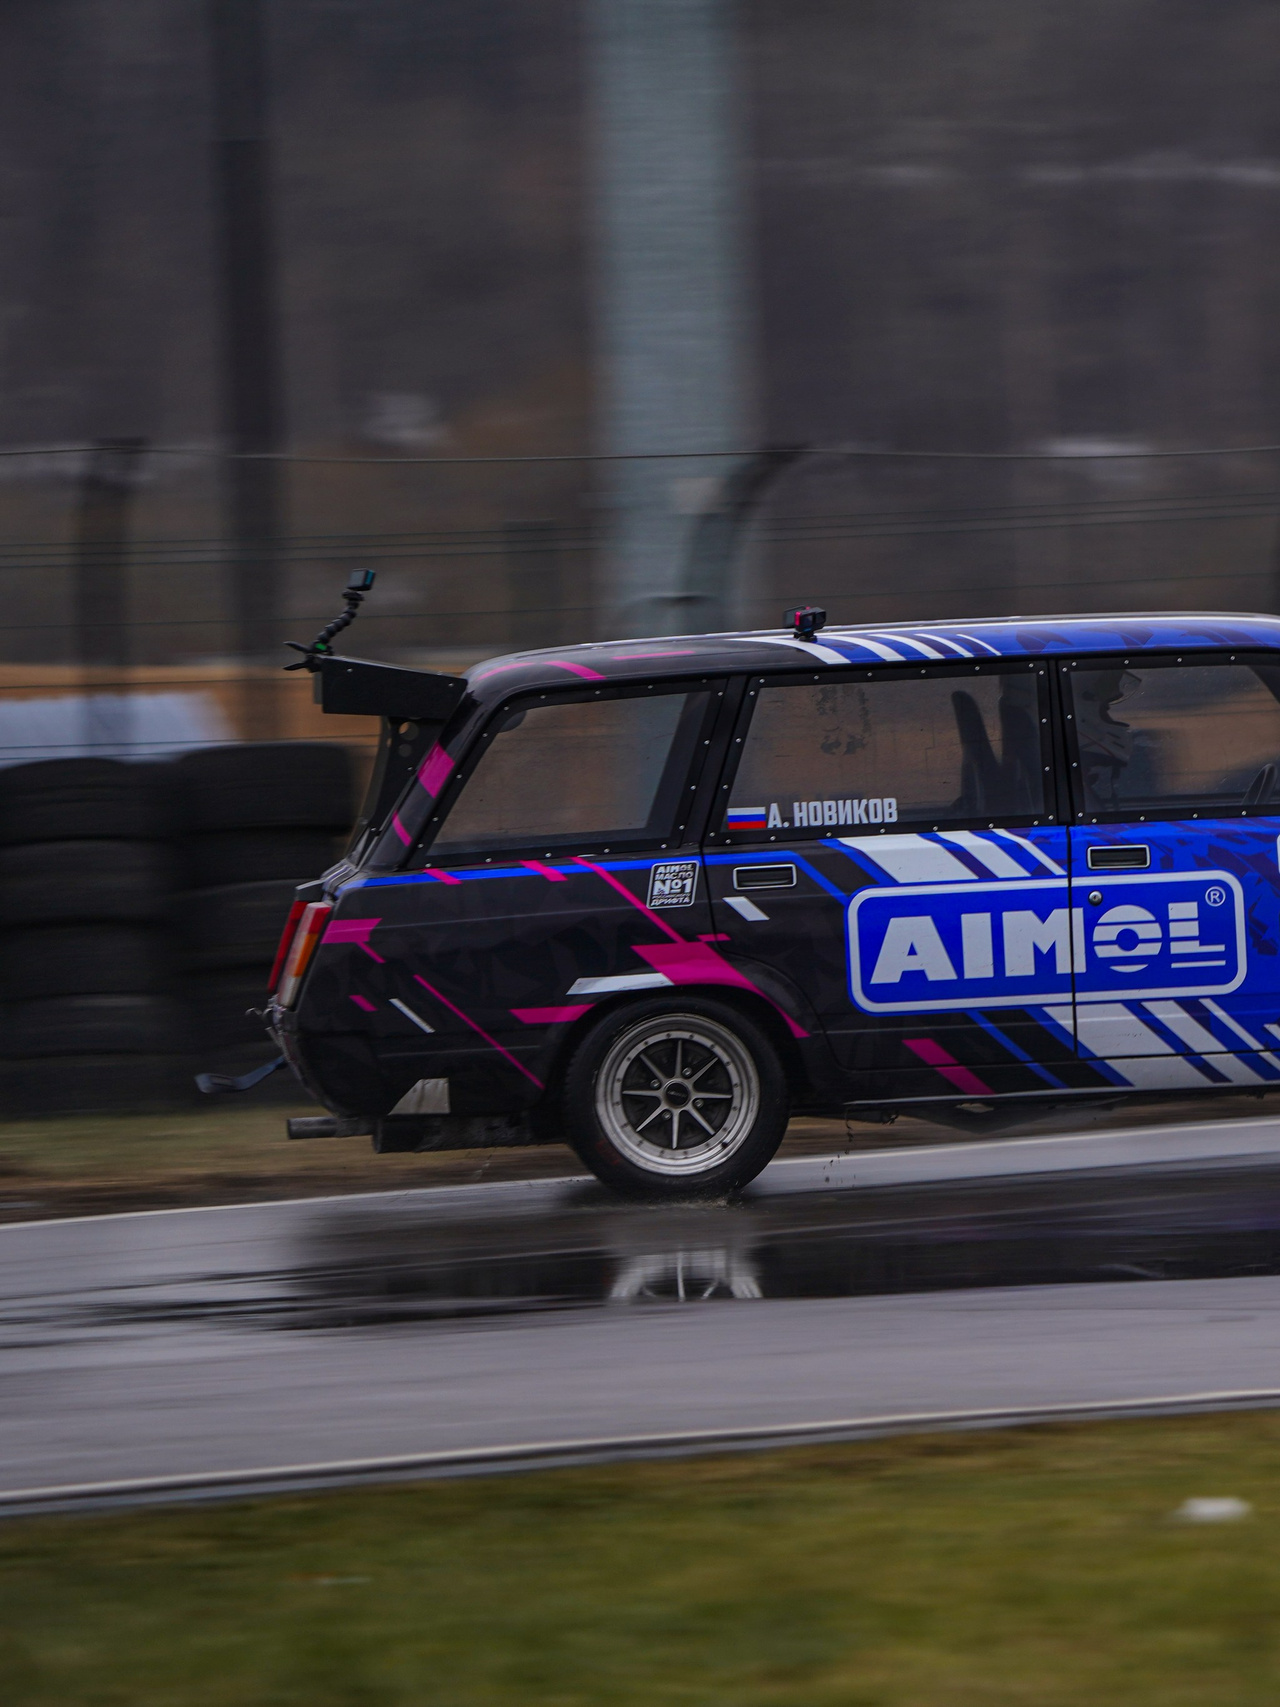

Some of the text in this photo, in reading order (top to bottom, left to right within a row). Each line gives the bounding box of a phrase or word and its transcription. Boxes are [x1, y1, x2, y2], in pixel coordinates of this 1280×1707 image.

[767, 797, 898, 829] А. НОВИКОВ
[869, 901, 1227, 985] AIMOL
